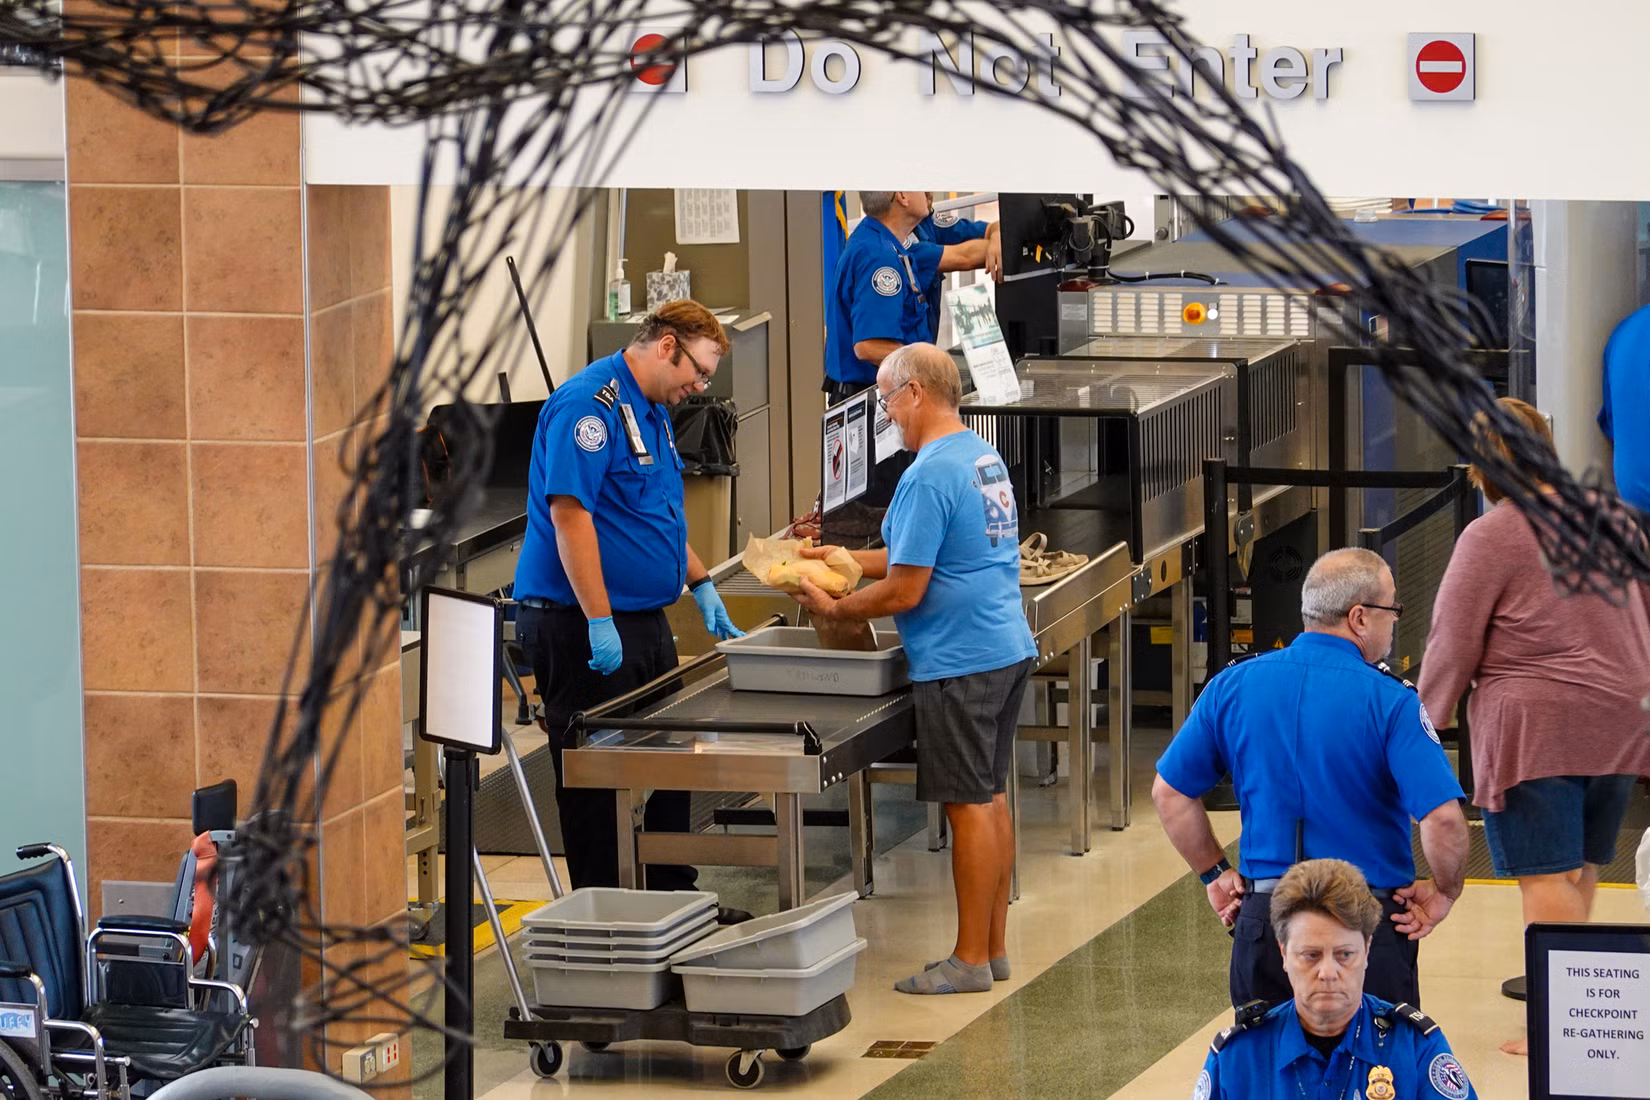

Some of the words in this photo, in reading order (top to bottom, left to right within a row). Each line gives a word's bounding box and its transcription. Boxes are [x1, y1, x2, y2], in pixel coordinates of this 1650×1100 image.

[750, 28, 862, 94] Do
[919, 31, 1062, 97] Not
[1123, 30, 1344, 100] Enter
[1566, 967, 1590, 978] THIS
[1593, 968, 1640, 979] SEATING
[1586, 988, 1596, 998] IS
[1598, 989, 1620, 999] FOR
[1569, 1007, 1638, 1019] CHECKPOINT
[1563, 1028, 1644, 1040] RE-GATHERING
[1587, 1049, 1620, 1060] ONLY.
